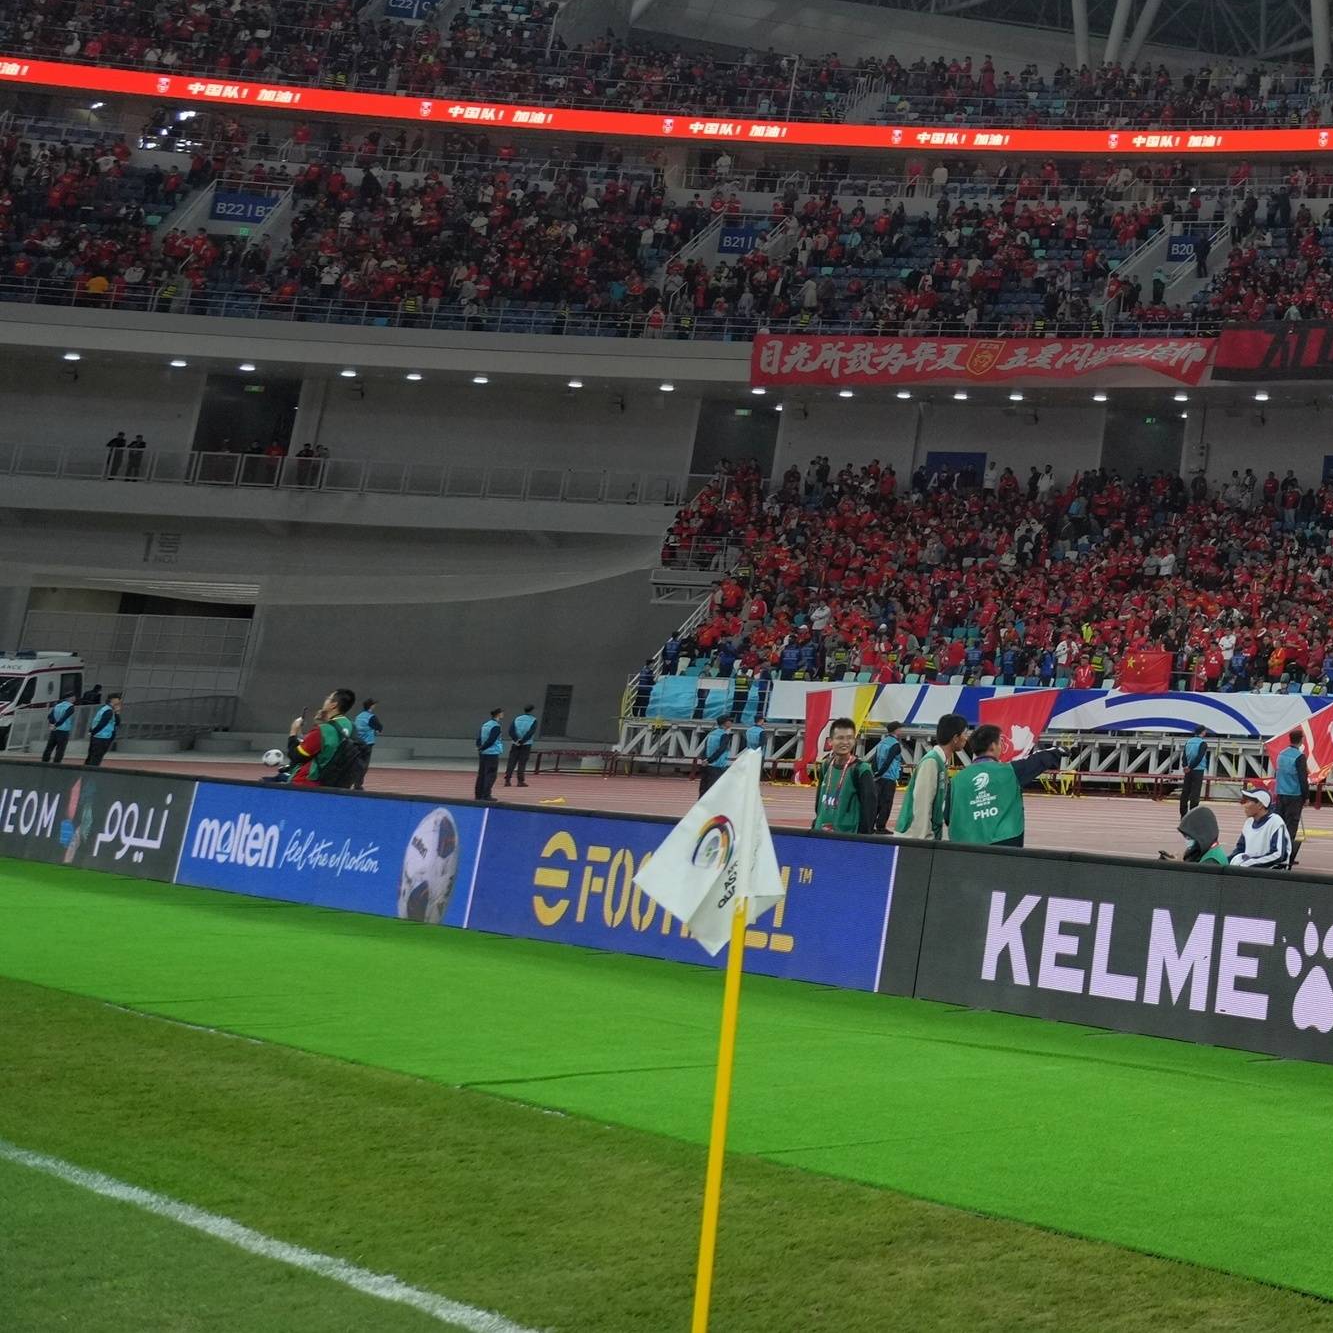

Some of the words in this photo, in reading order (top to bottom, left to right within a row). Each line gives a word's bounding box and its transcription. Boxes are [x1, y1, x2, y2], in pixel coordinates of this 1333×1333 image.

[215, 202, 245, 216] B22
[722, 235, 746, 249] B21
[1170, 242, 1194, 257] B20
[93, 793, 173, 864] نيوم
[191, 813, 280, 868] molten
[279, 829, 306, 870] feel
[981, 891, 1278, 1021] KELME
